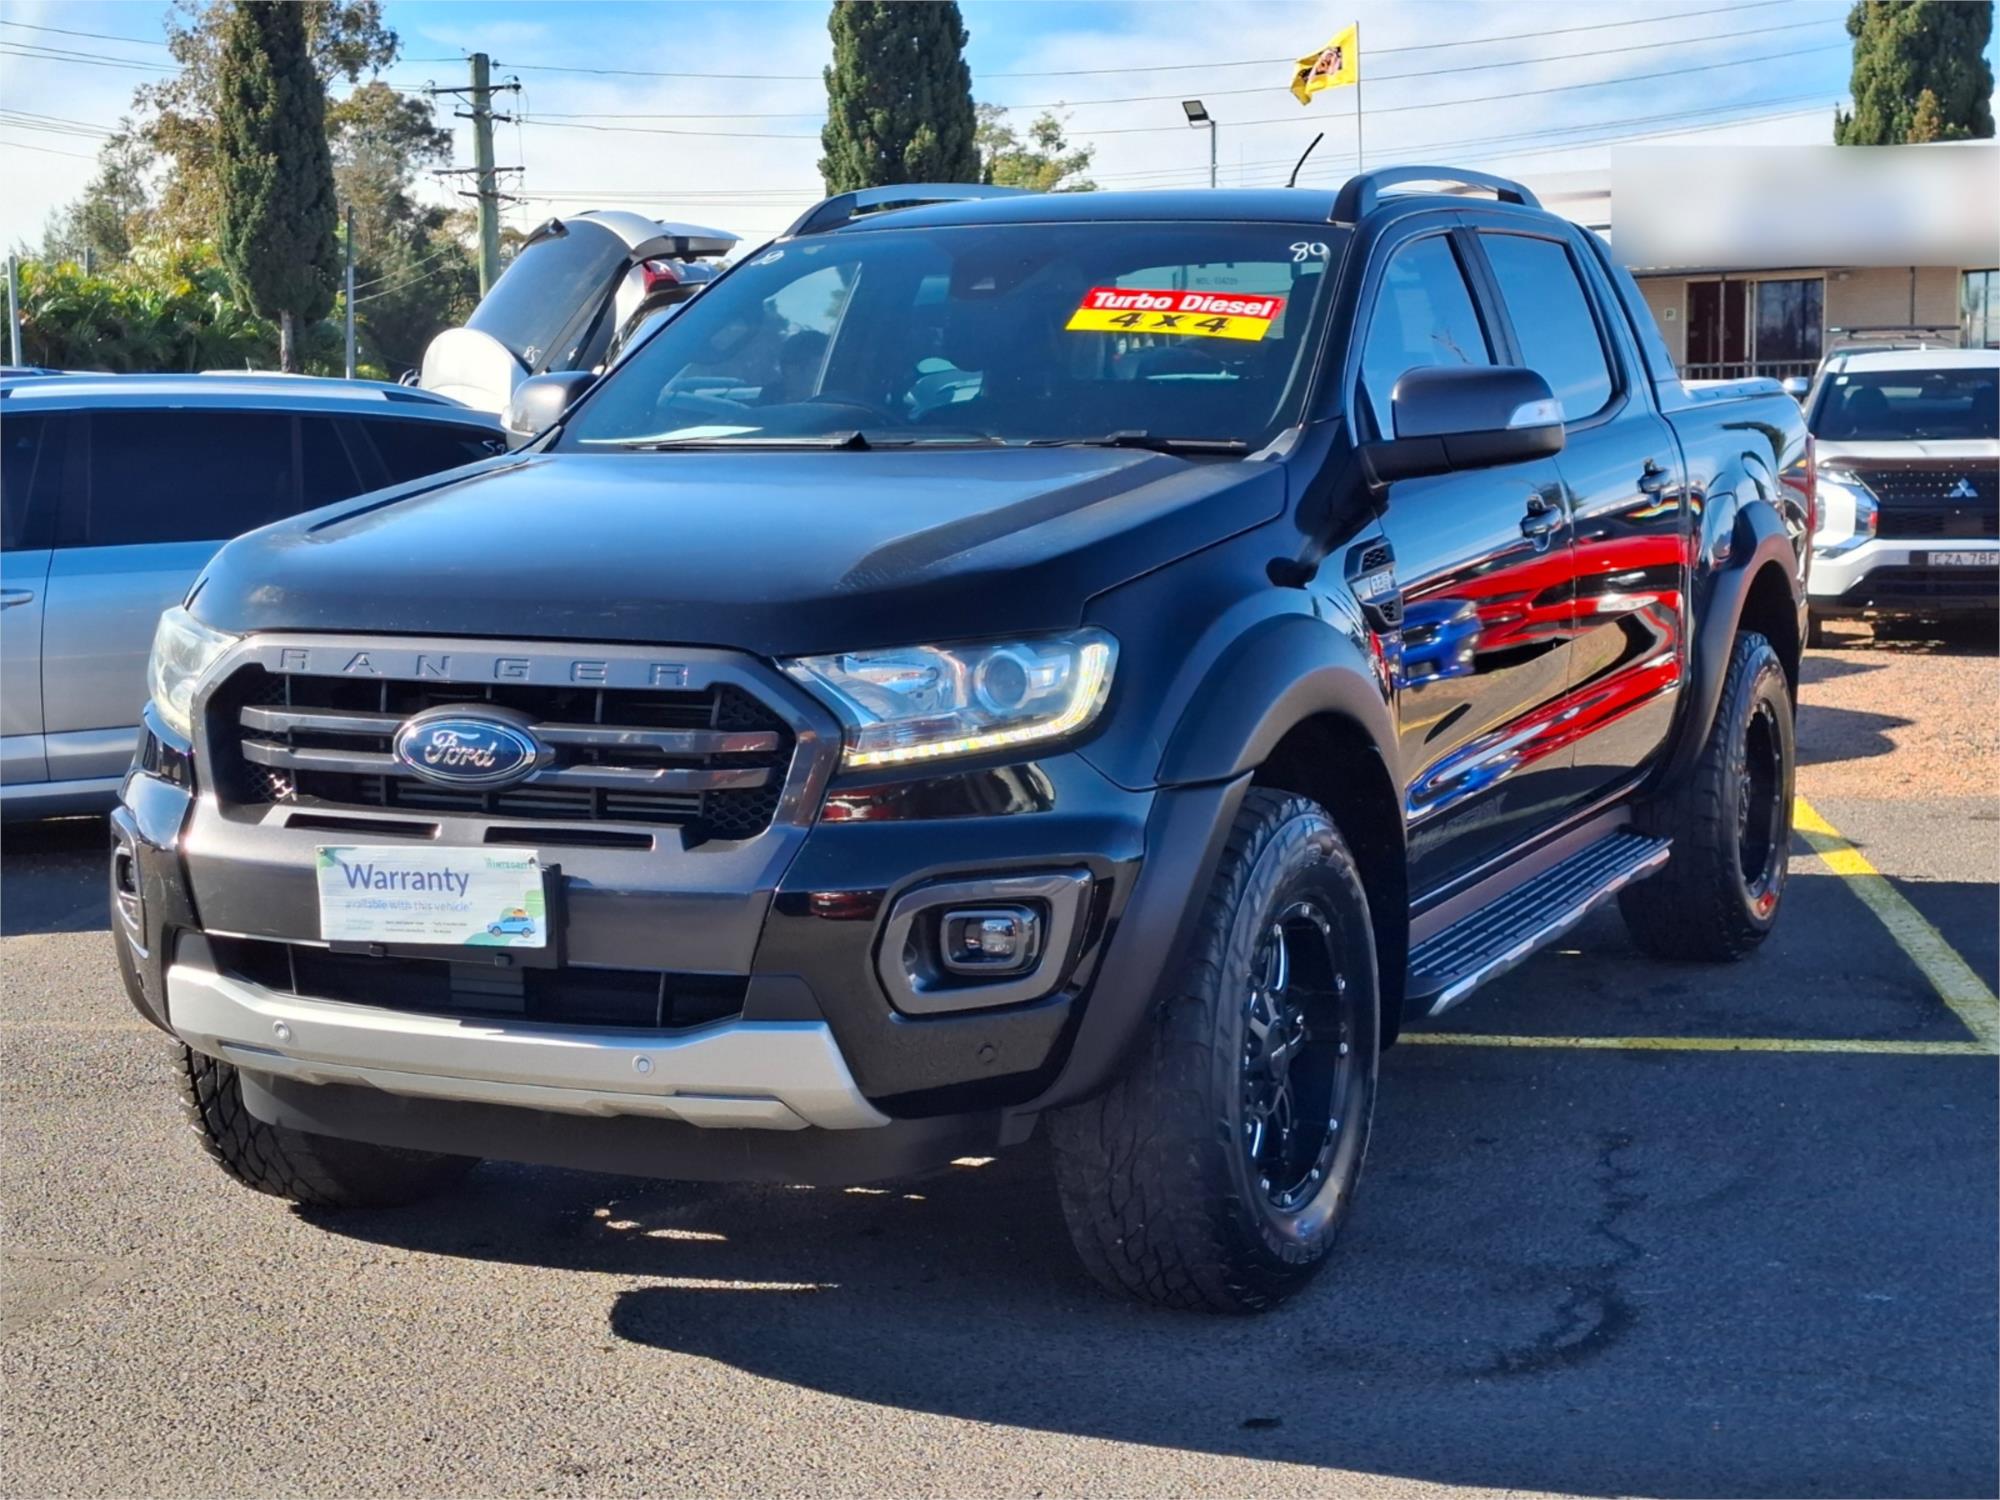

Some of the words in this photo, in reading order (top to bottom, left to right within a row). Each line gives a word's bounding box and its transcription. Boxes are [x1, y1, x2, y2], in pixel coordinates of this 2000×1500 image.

[1093, 291, 1174, 311] Turbo
[1179, 294, 1274, 317] Diesel
[1109, 312, 1143, 329] 4
[1194, 316, 1230, 333] 4
[279, 647, 689, 688] RANGER
[424, 729, 498, 768] Ford
[342, 863, 469, 898] Warranty
